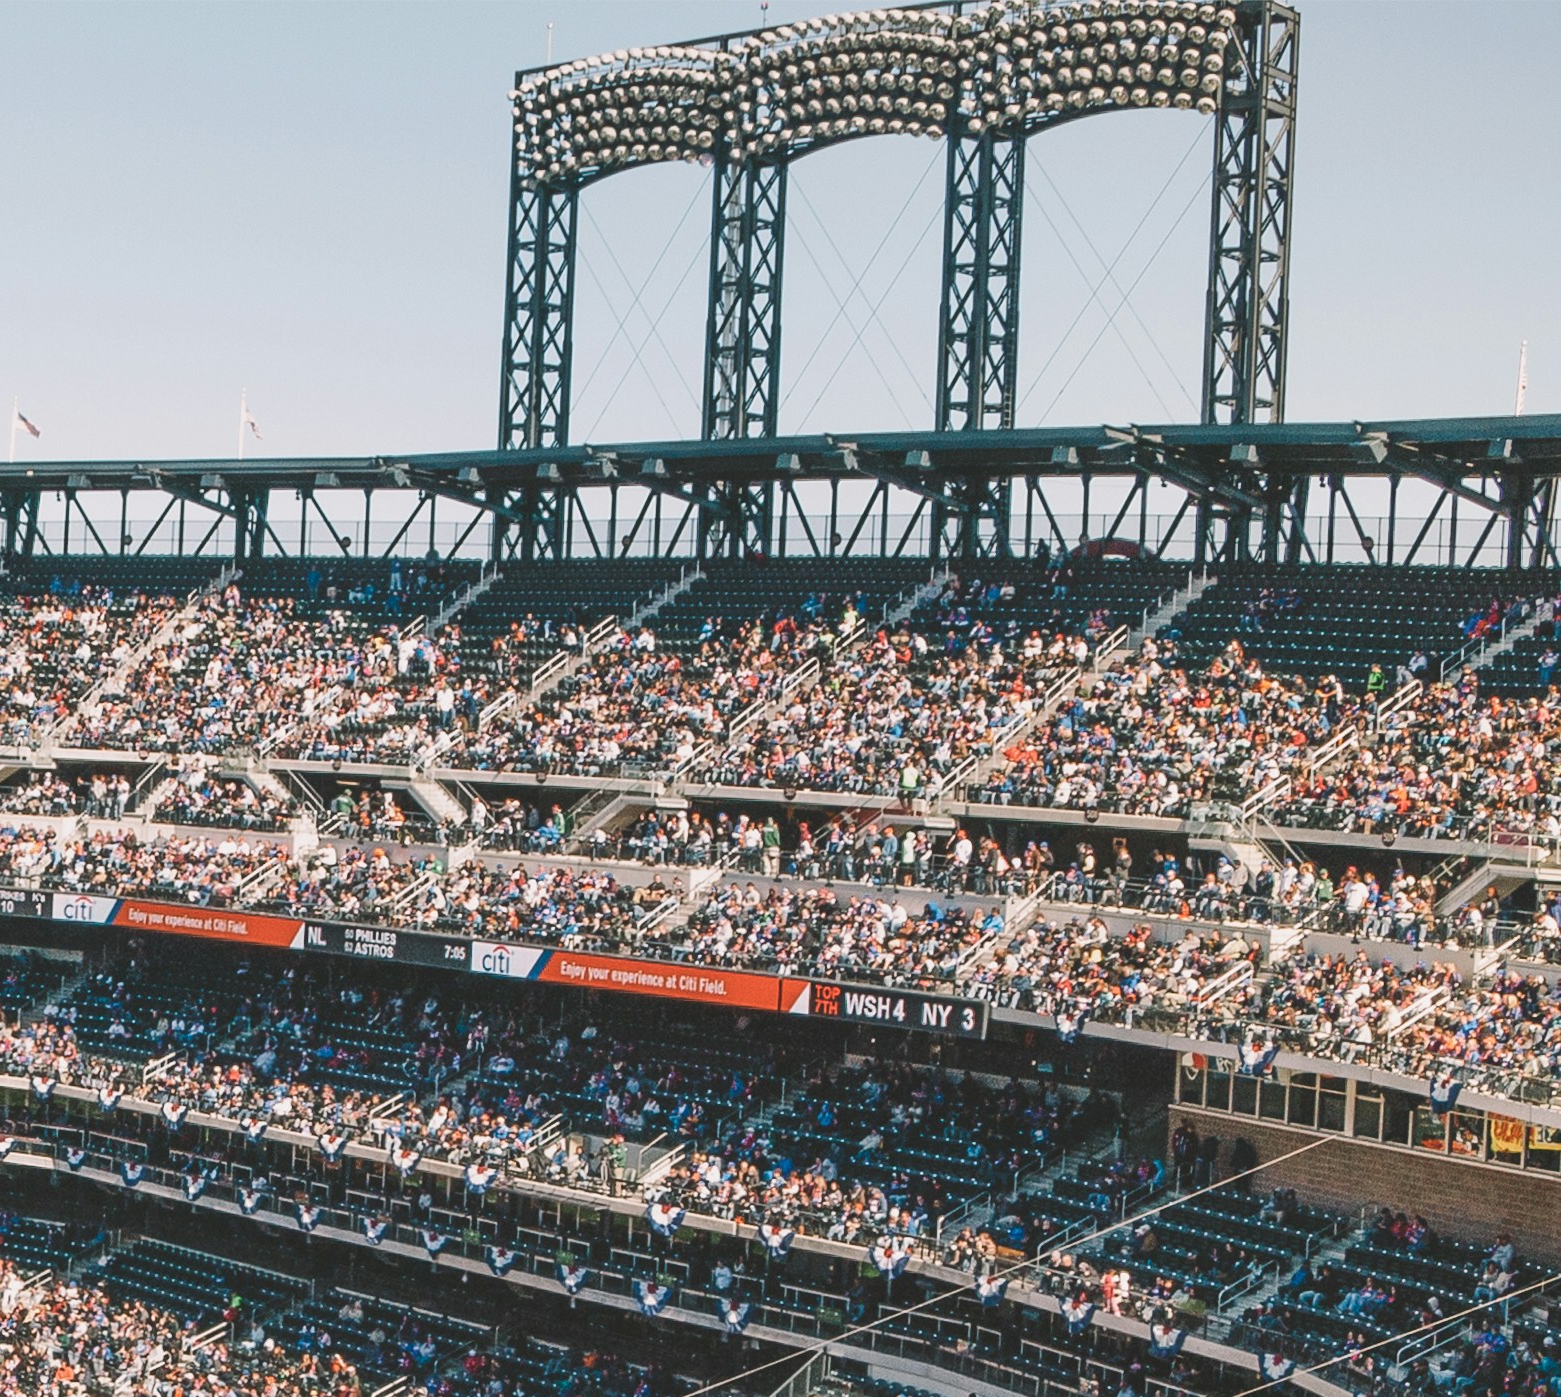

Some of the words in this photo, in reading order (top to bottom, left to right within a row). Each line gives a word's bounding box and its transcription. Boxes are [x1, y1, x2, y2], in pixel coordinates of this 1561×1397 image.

[307, 926, 327, 946] NL
[354, 929, 397, 945] PHILLIES
[444, 944, 466, 960] 7:05
[353, 943, 395, 959] ASTROS
[482, 954, 510, 973] citi
[560, 960, 587, 980] Enjoy
[587, 966, 609, 982] your
[611, 969, 664, 987] experience
[665, 974, 677, 988] at
[678, 975, 697, 990] Citi
[699, 978, 727, 996] Field.
[814, 998, 839, 1015] 7TH
[814, 984, 841, 1000] TOP
[844, 992, 890, 1021] WSH
[893, 998, 906, 1021] 4
[921, 1002, 951, 1027] NY
[961, 1006, 975, 1030] 3
